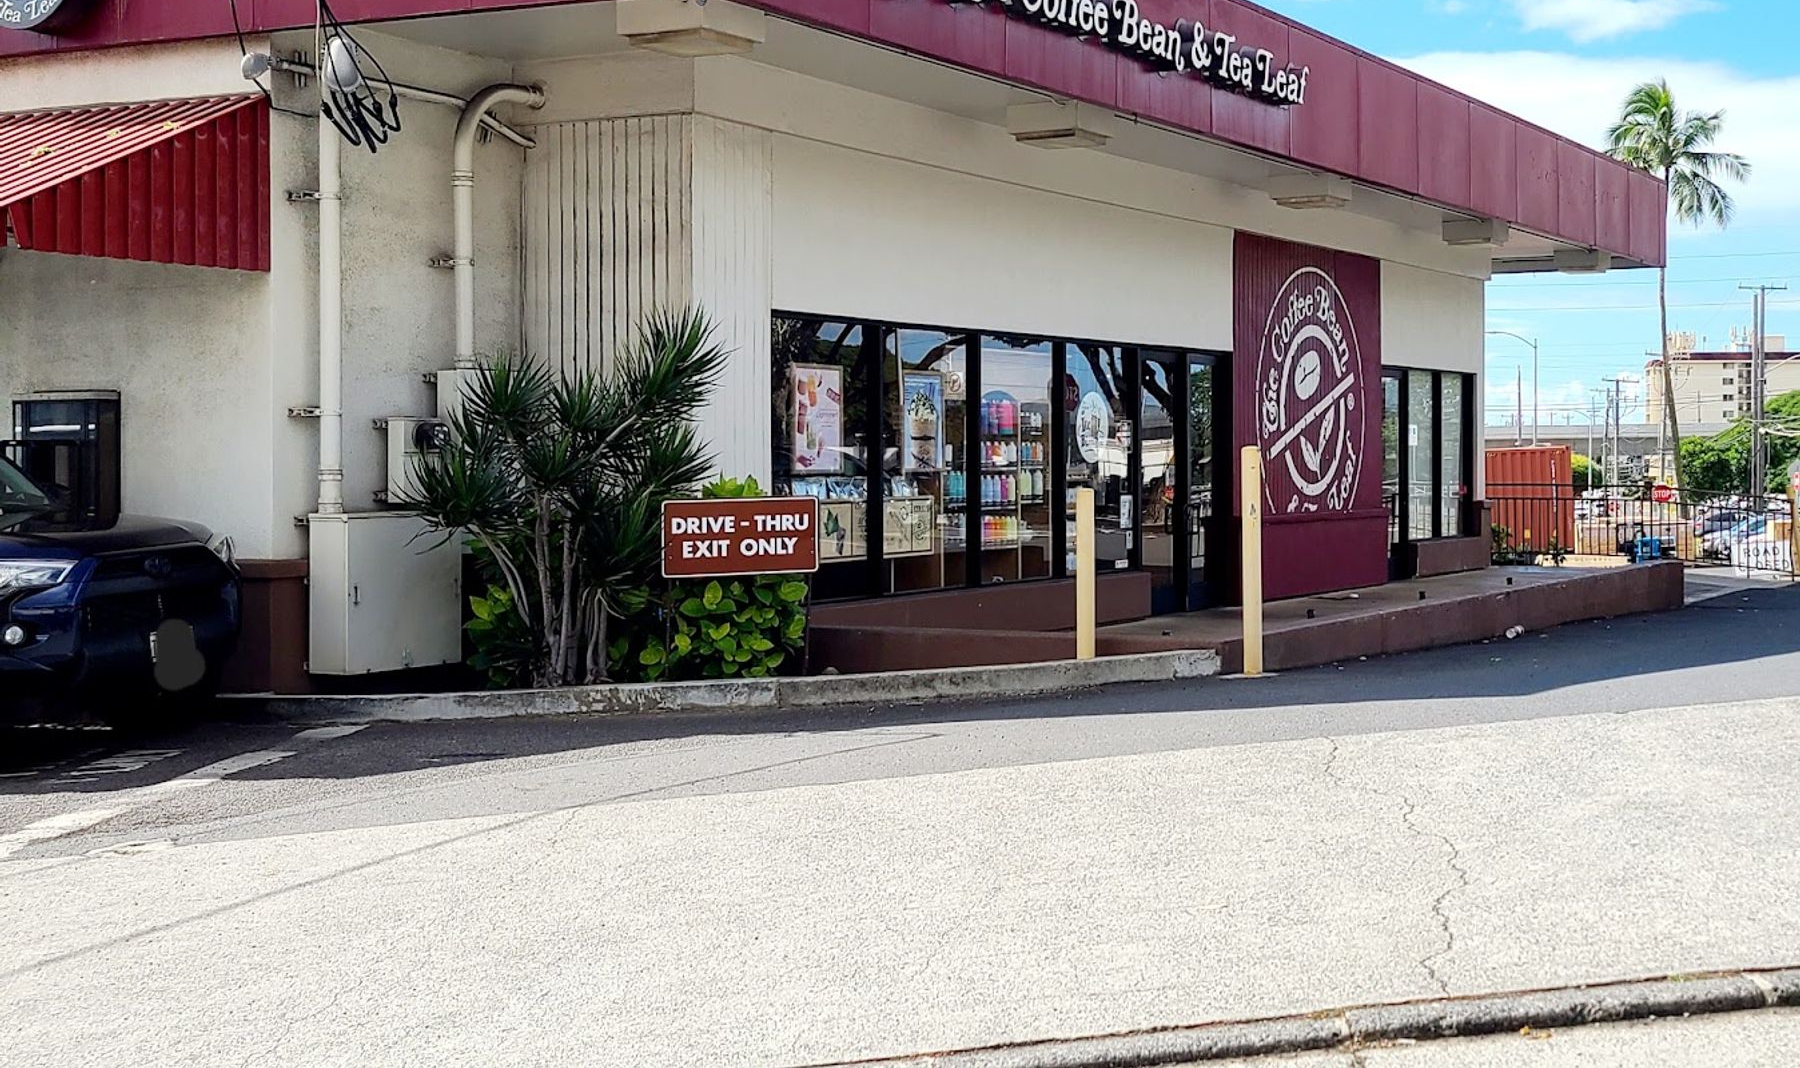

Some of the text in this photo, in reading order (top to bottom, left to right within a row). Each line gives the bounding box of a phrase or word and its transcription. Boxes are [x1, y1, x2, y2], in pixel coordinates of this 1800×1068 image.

[1191, 21, 1212, 69] &
[1213, 32, 1252, 89] Tea
[1256, 48, 1310, 105] Leaf
[1262, 285, 1349, 439] The Coffee Bean
[1328, 430, 1356, 511] Leaf
[1654, 489, 1671, 499] STOP
[682, 537, 799, 559] EXIT ONLY
[1743, 547, 1780, 557] ROAD
